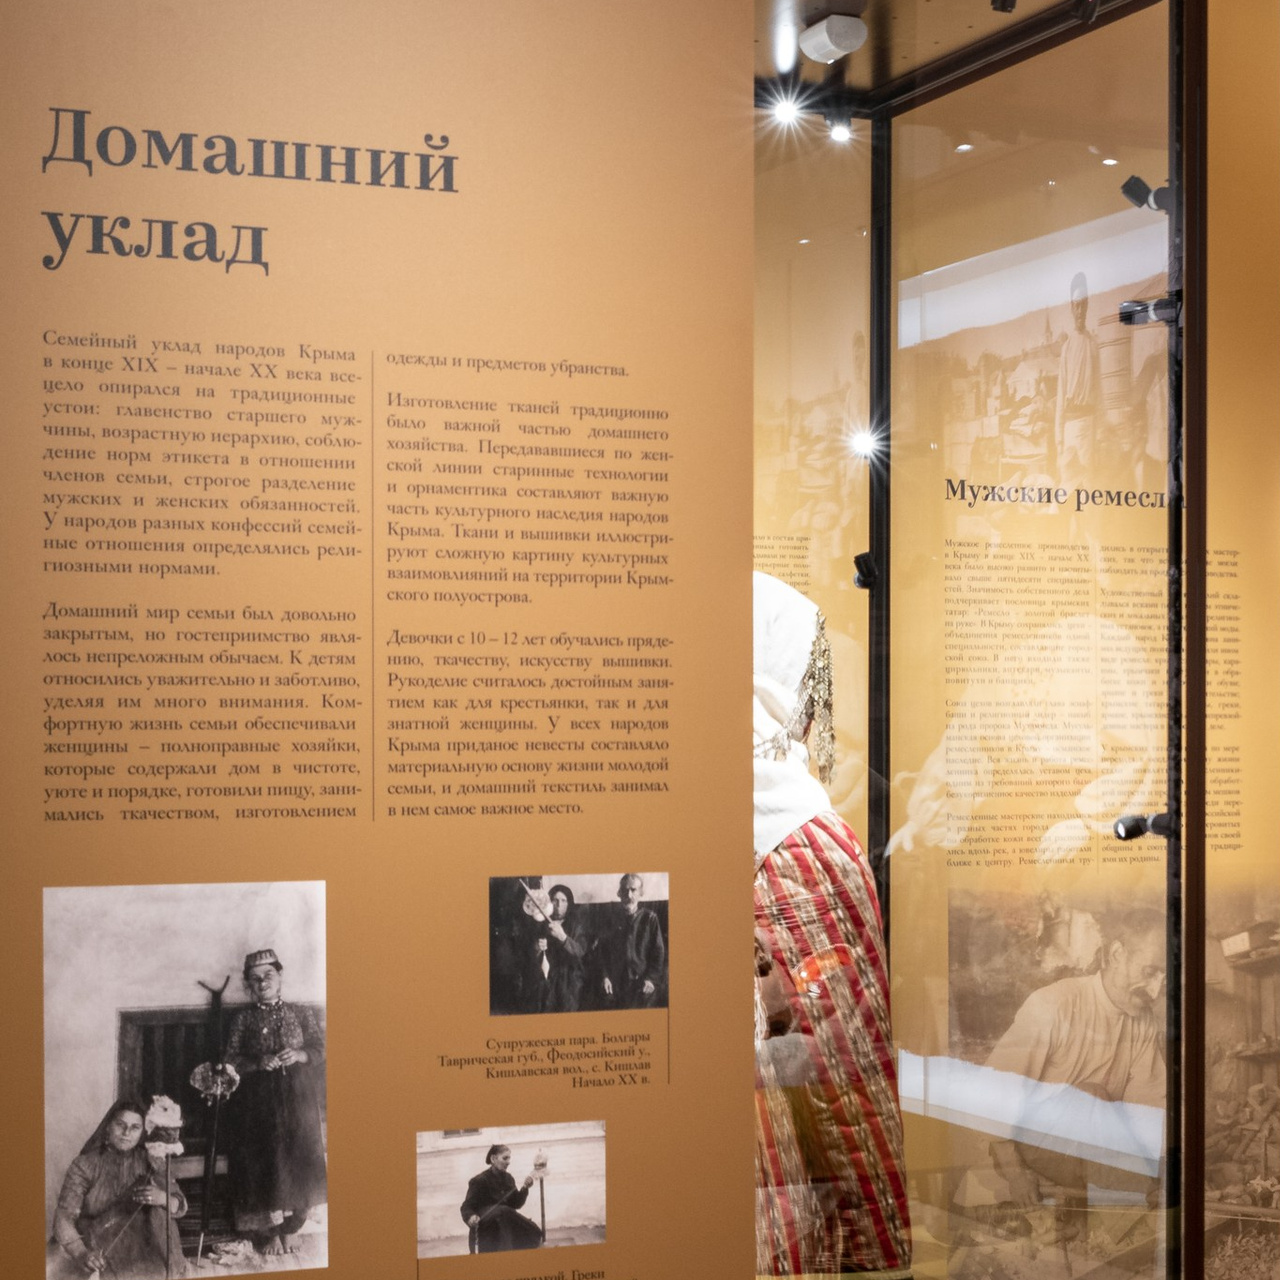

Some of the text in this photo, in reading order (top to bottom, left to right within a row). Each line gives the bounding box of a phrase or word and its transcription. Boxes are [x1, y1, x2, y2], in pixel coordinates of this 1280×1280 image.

[41, 106, 460, 194] Домашний
[41, 209, 270, 275] уклад
[41, 328, 356, 364] Семейный уклад народов Крыма
[42, 355, 53, 368] в
[60, 357, 113, 374] конце
[120, 355, 159, 373] XIX
[184, 363, 242, 378] начале
[248, 361, 278, 380] XX
[285, 368, 322, 382] века
[329, 370, 362, 384] все-
[385, 352, 629, 378] одежды и предметов убранства.
[42, 378, 356, 405] цело опирался на традиционные
[41, 401, 362, 431] устои: главенство старшего муж-
[386, 391, 669, 421] Изготовление тканей традиционно
[41, 424, 362, 449] чины, возрастную иерархию, соблю-
[385, 412, 669, 441] было важной частью домашнего
[41, 446, 355, 470] дение норм этикета в отношении
[386, 435, 674, 462] хозяйства. Передававшиеся по жен-
[42, 469, 356, 493] членов семьи, строгое разделение
[42, 492, 360, 513] мужских и женских обязанностей.
[945, 479, 1187, 511] Мужские ремесл
[42, 509, 362, 537] У народов разных конфессий семей-
[42, 537, 362, 561] ные отношения определялись рели-
[42, 560, 221, 580] гиозными нормами.
[41, 600, 356, 624] Домашний мир семьи был довольно
[385, 589, 533, 608] ского полуострова.
